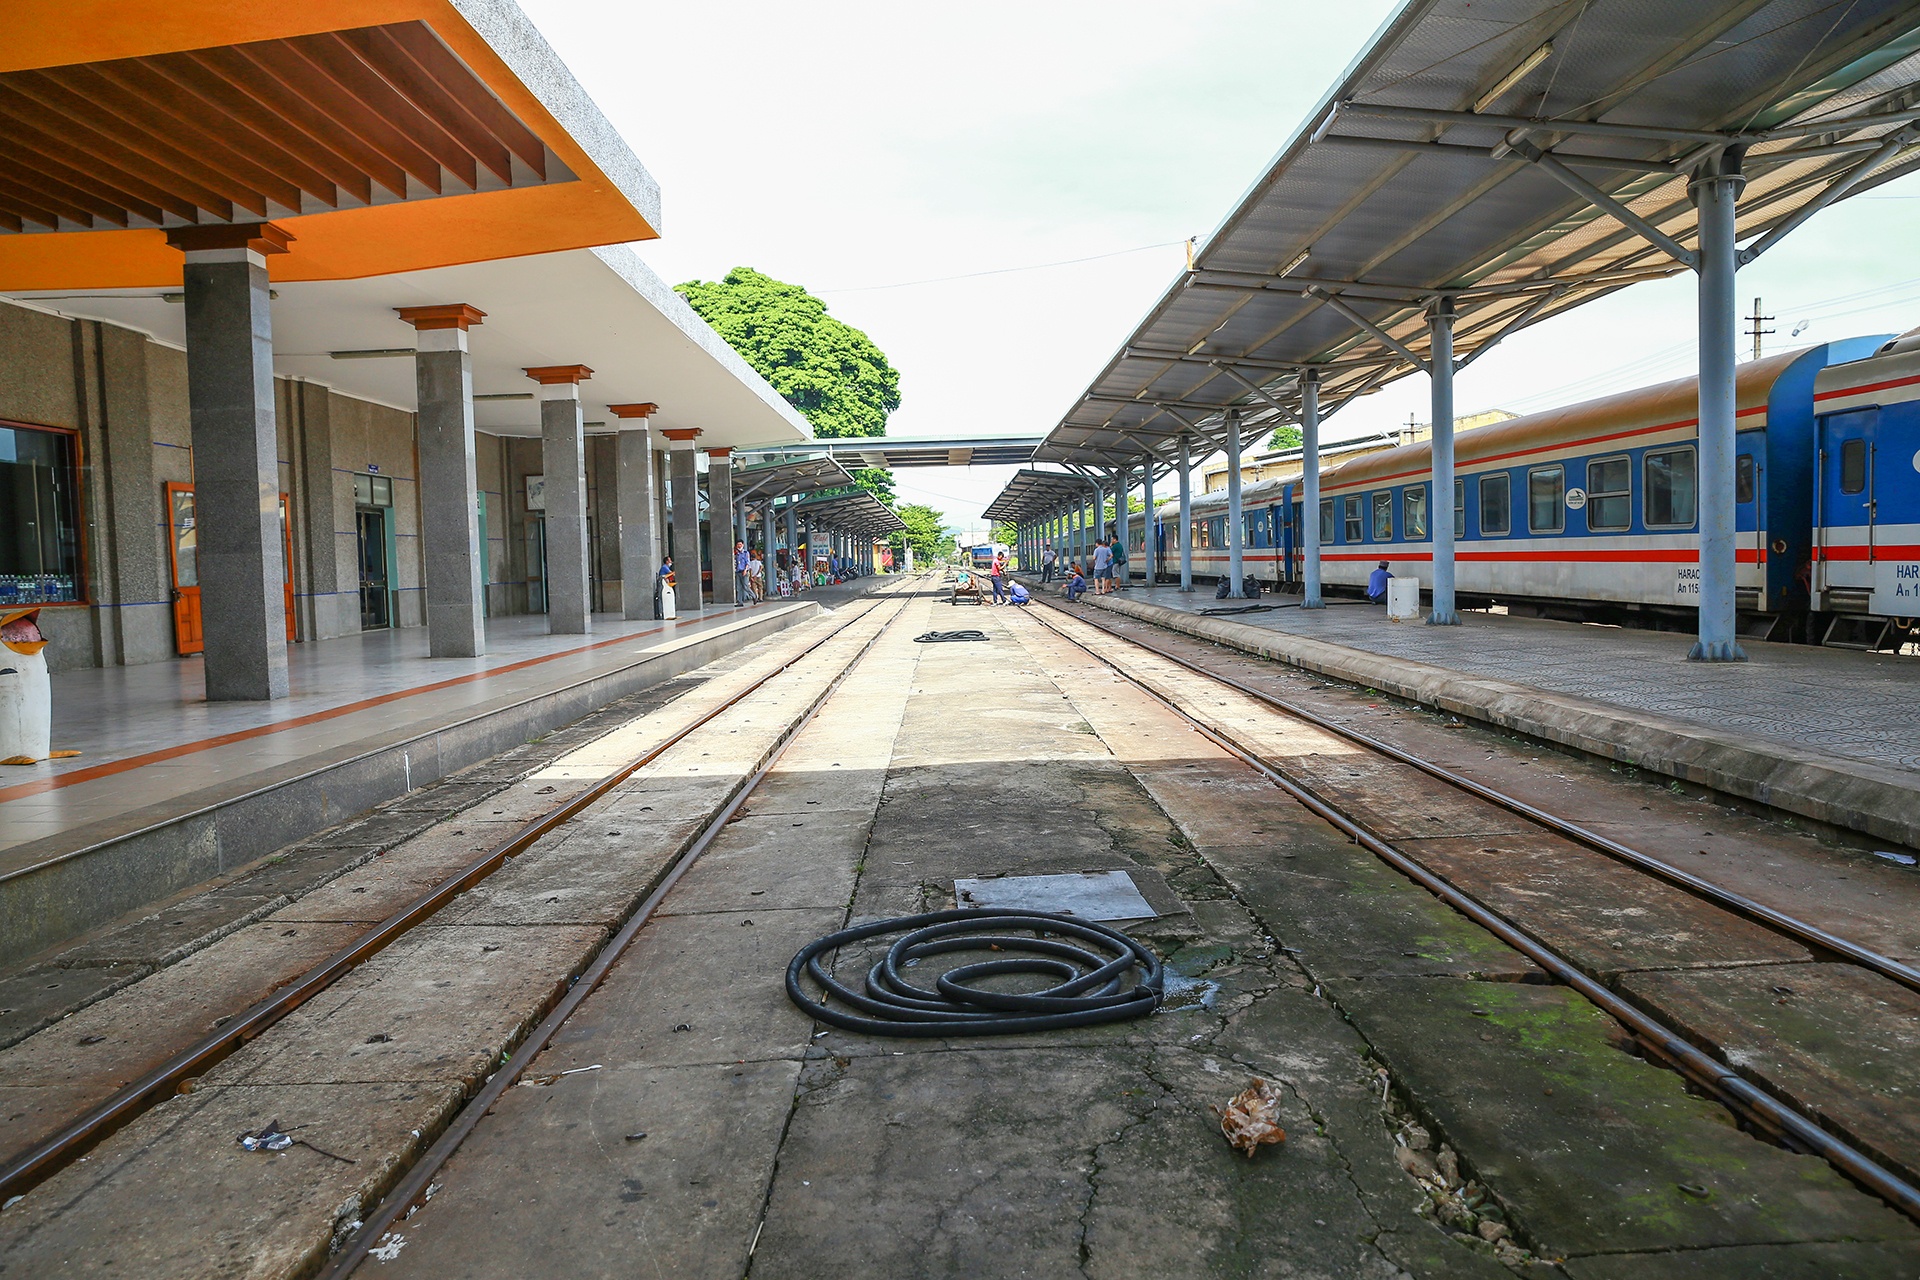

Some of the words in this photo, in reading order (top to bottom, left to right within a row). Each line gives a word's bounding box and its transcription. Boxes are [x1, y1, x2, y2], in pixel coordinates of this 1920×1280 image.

[1897, 565, 1920, 578] HAR
[1678, 583, 1686, 593] An
[1688, 583, 1700, 594] 115
[1896, 583, 1910, 596] An
[1914, 583, 1920, 597] 1
